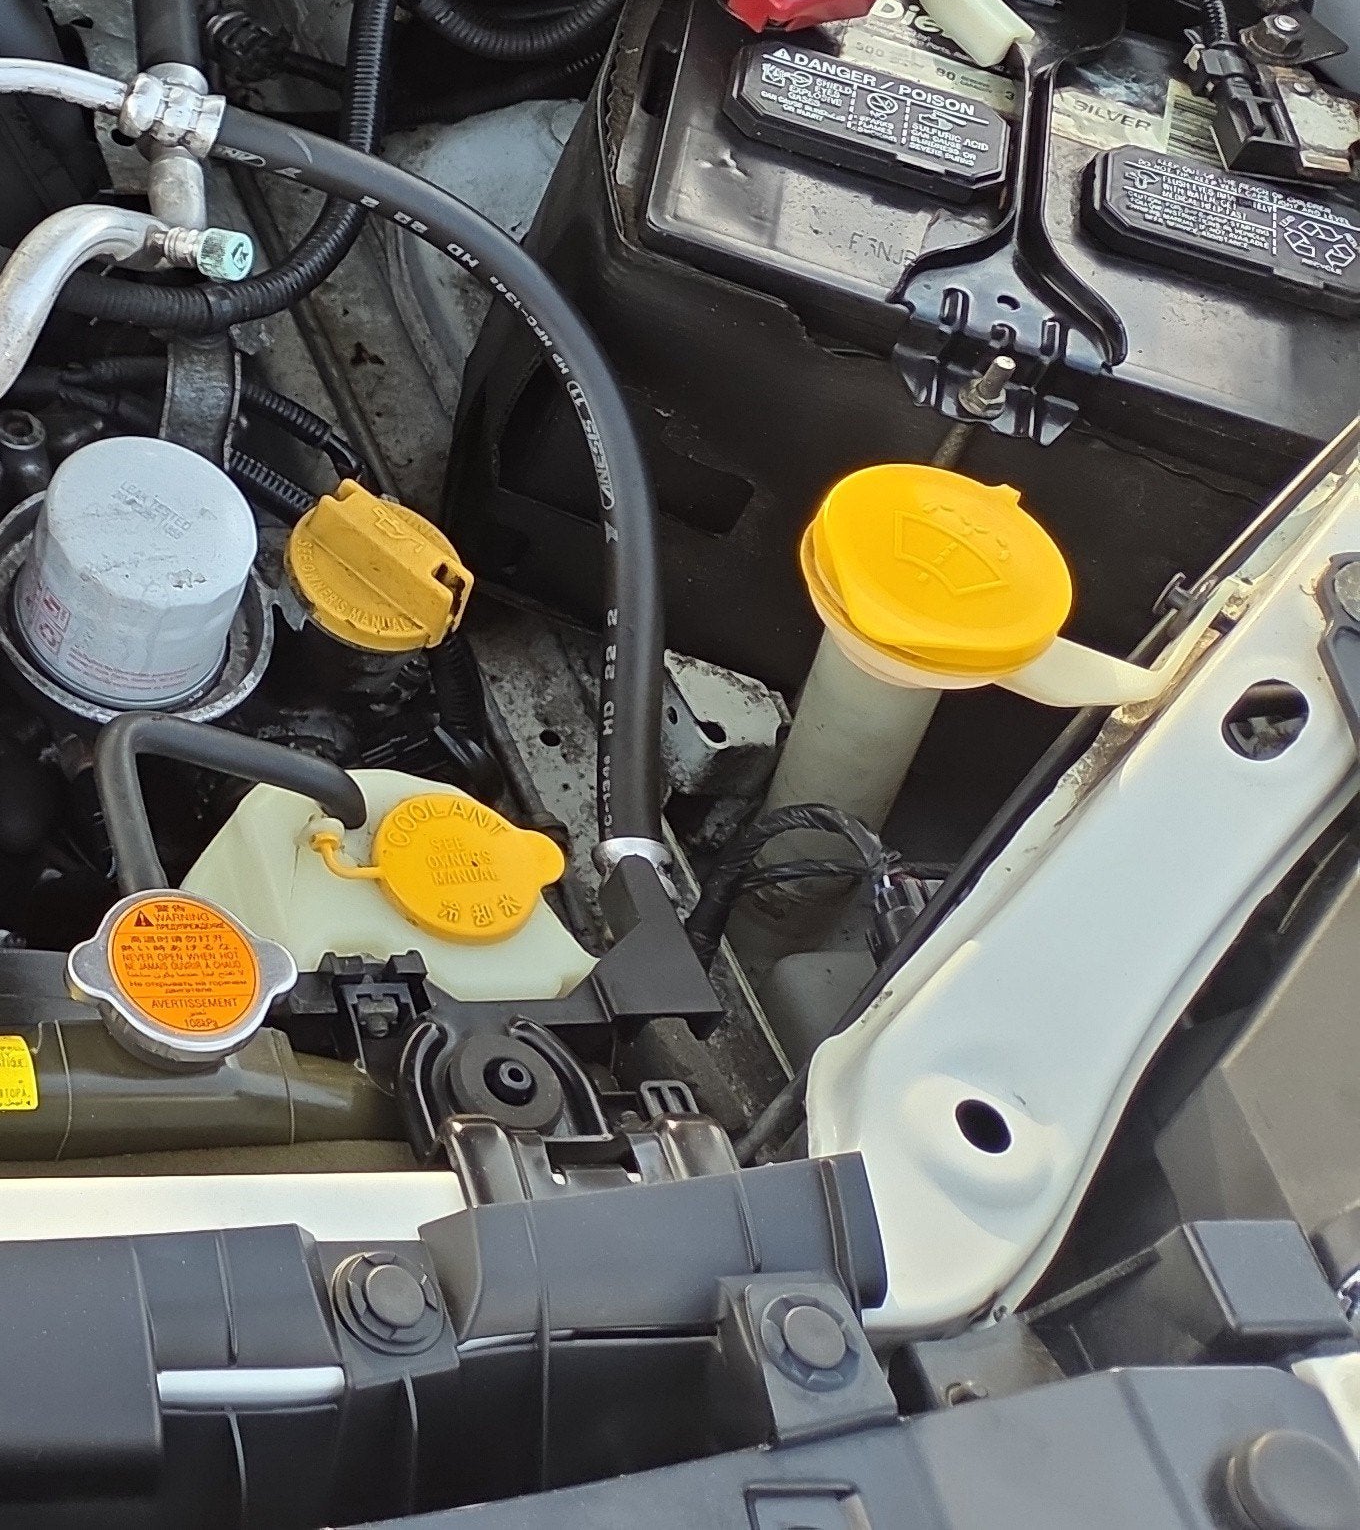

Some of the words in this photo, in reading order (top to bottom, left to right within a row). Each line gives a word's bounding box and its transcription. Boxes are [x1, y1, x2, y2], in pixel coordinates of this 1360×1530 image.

[794, 53, 877, 87] DANGER
[898, 85, 975, 116] POISON
[870, 110, 887, 120] NO
[1072, 100, 1151, 131] SILVER
[911, 122, 962, 143] SULFURIC
[963, 138, 989, 151] ACID
[446, 243, 479, 268] HD
[150, 494, 192, 531] TESTED
[351, 607, 411, 632] MANUAL
[607, 608, 618, 627] 2
[604, 644, 617, 680] 22
[602, 700, 615, 736] HD
[386, 799, 508, 847] COOLANT
[430, 836, 464, 851] SEE
[426, 849, 494, 869] OWNERS
[431, 867, 499, 886] MANUAL
[153, 912, 210, 921] WARNING
[122, 952, 153, 962] NEVER
[157, 952, 183, 962] OPEN
[187, 952, 216, 961] WHEN
[220, 951, 239, 960] HOT
[151, 998, 238, 1008] AVERTISSEMENT
